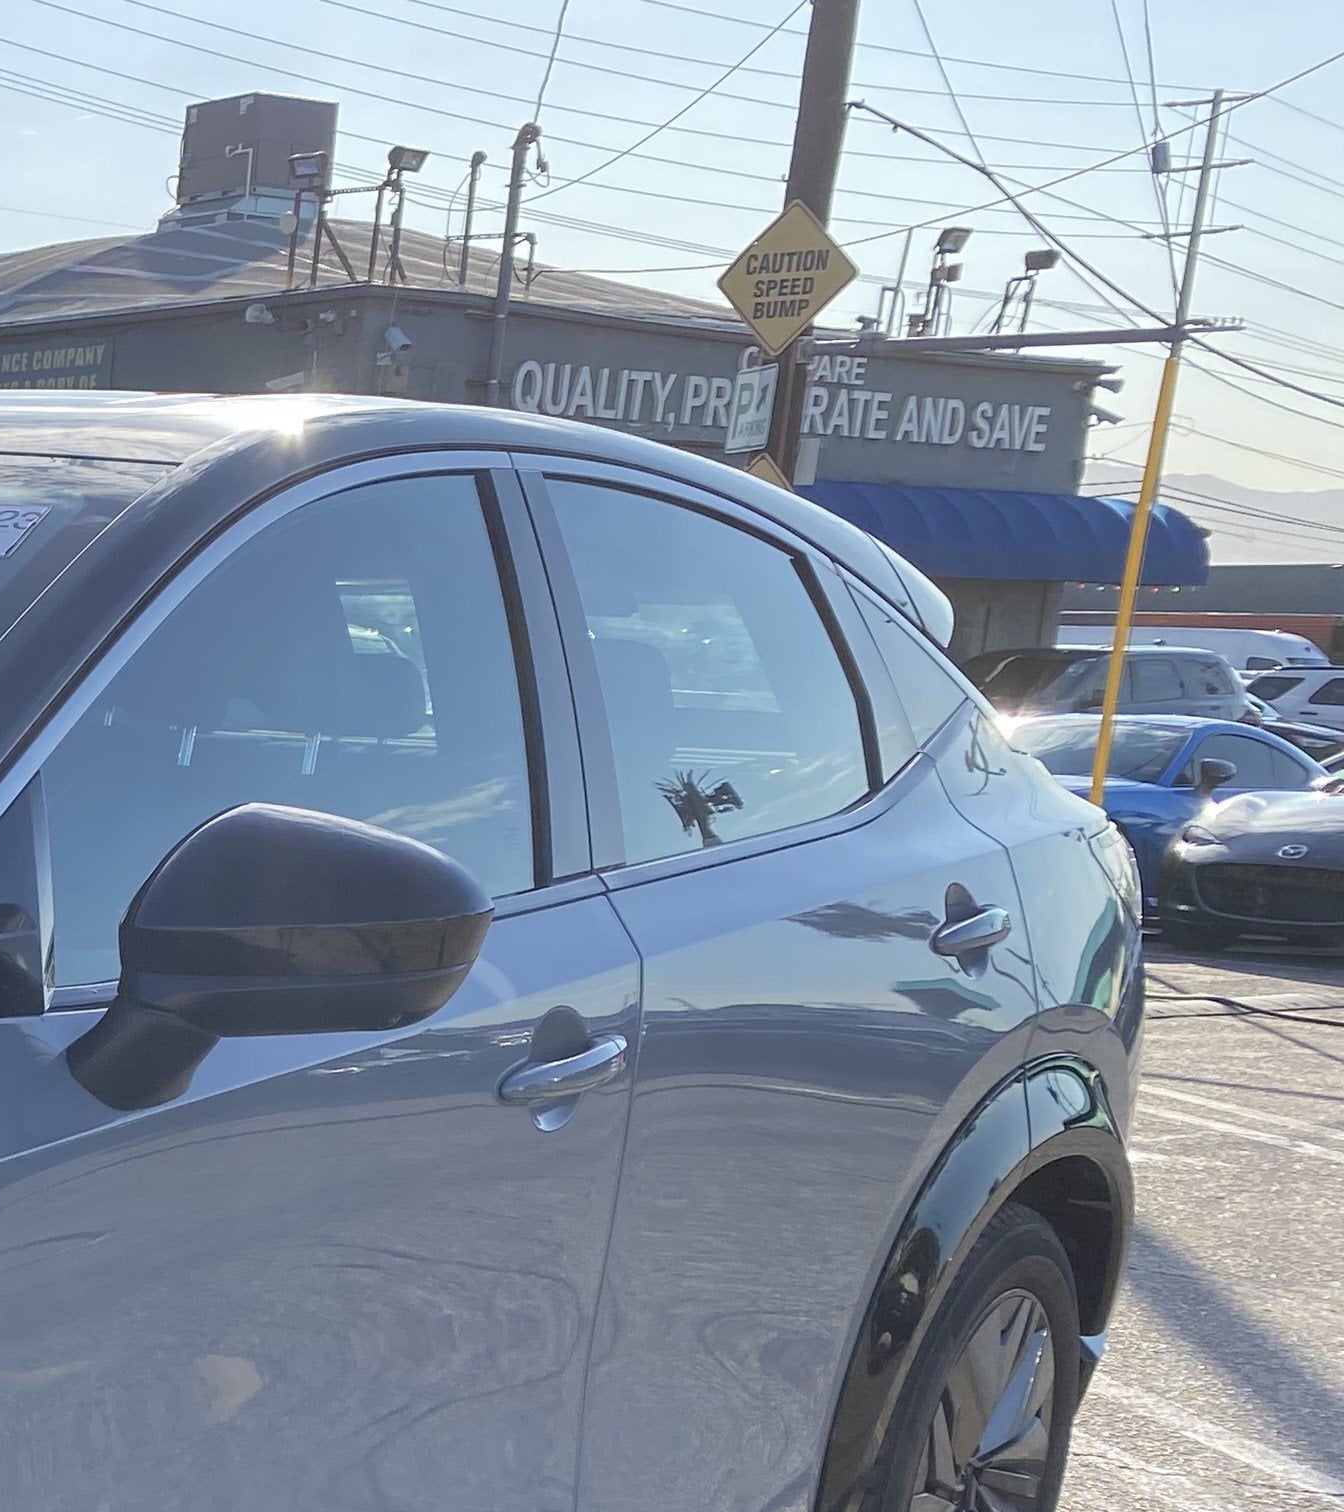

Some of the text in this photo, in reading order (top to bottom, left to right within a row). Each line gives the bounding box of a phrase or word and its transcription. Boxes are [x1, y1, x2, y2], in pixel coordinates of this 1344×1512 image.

[746, 249, 831, 275] CAUTION
[753, 277, 815, 298] SPEED
[752, 299, 810, 320] BUMP
[32, 344, 106, 371] COMPANY
[799, 386, 892, 440] RATE
[895, 395, 966, 445] AND
[968, 401, 1051, 452] SAVE
